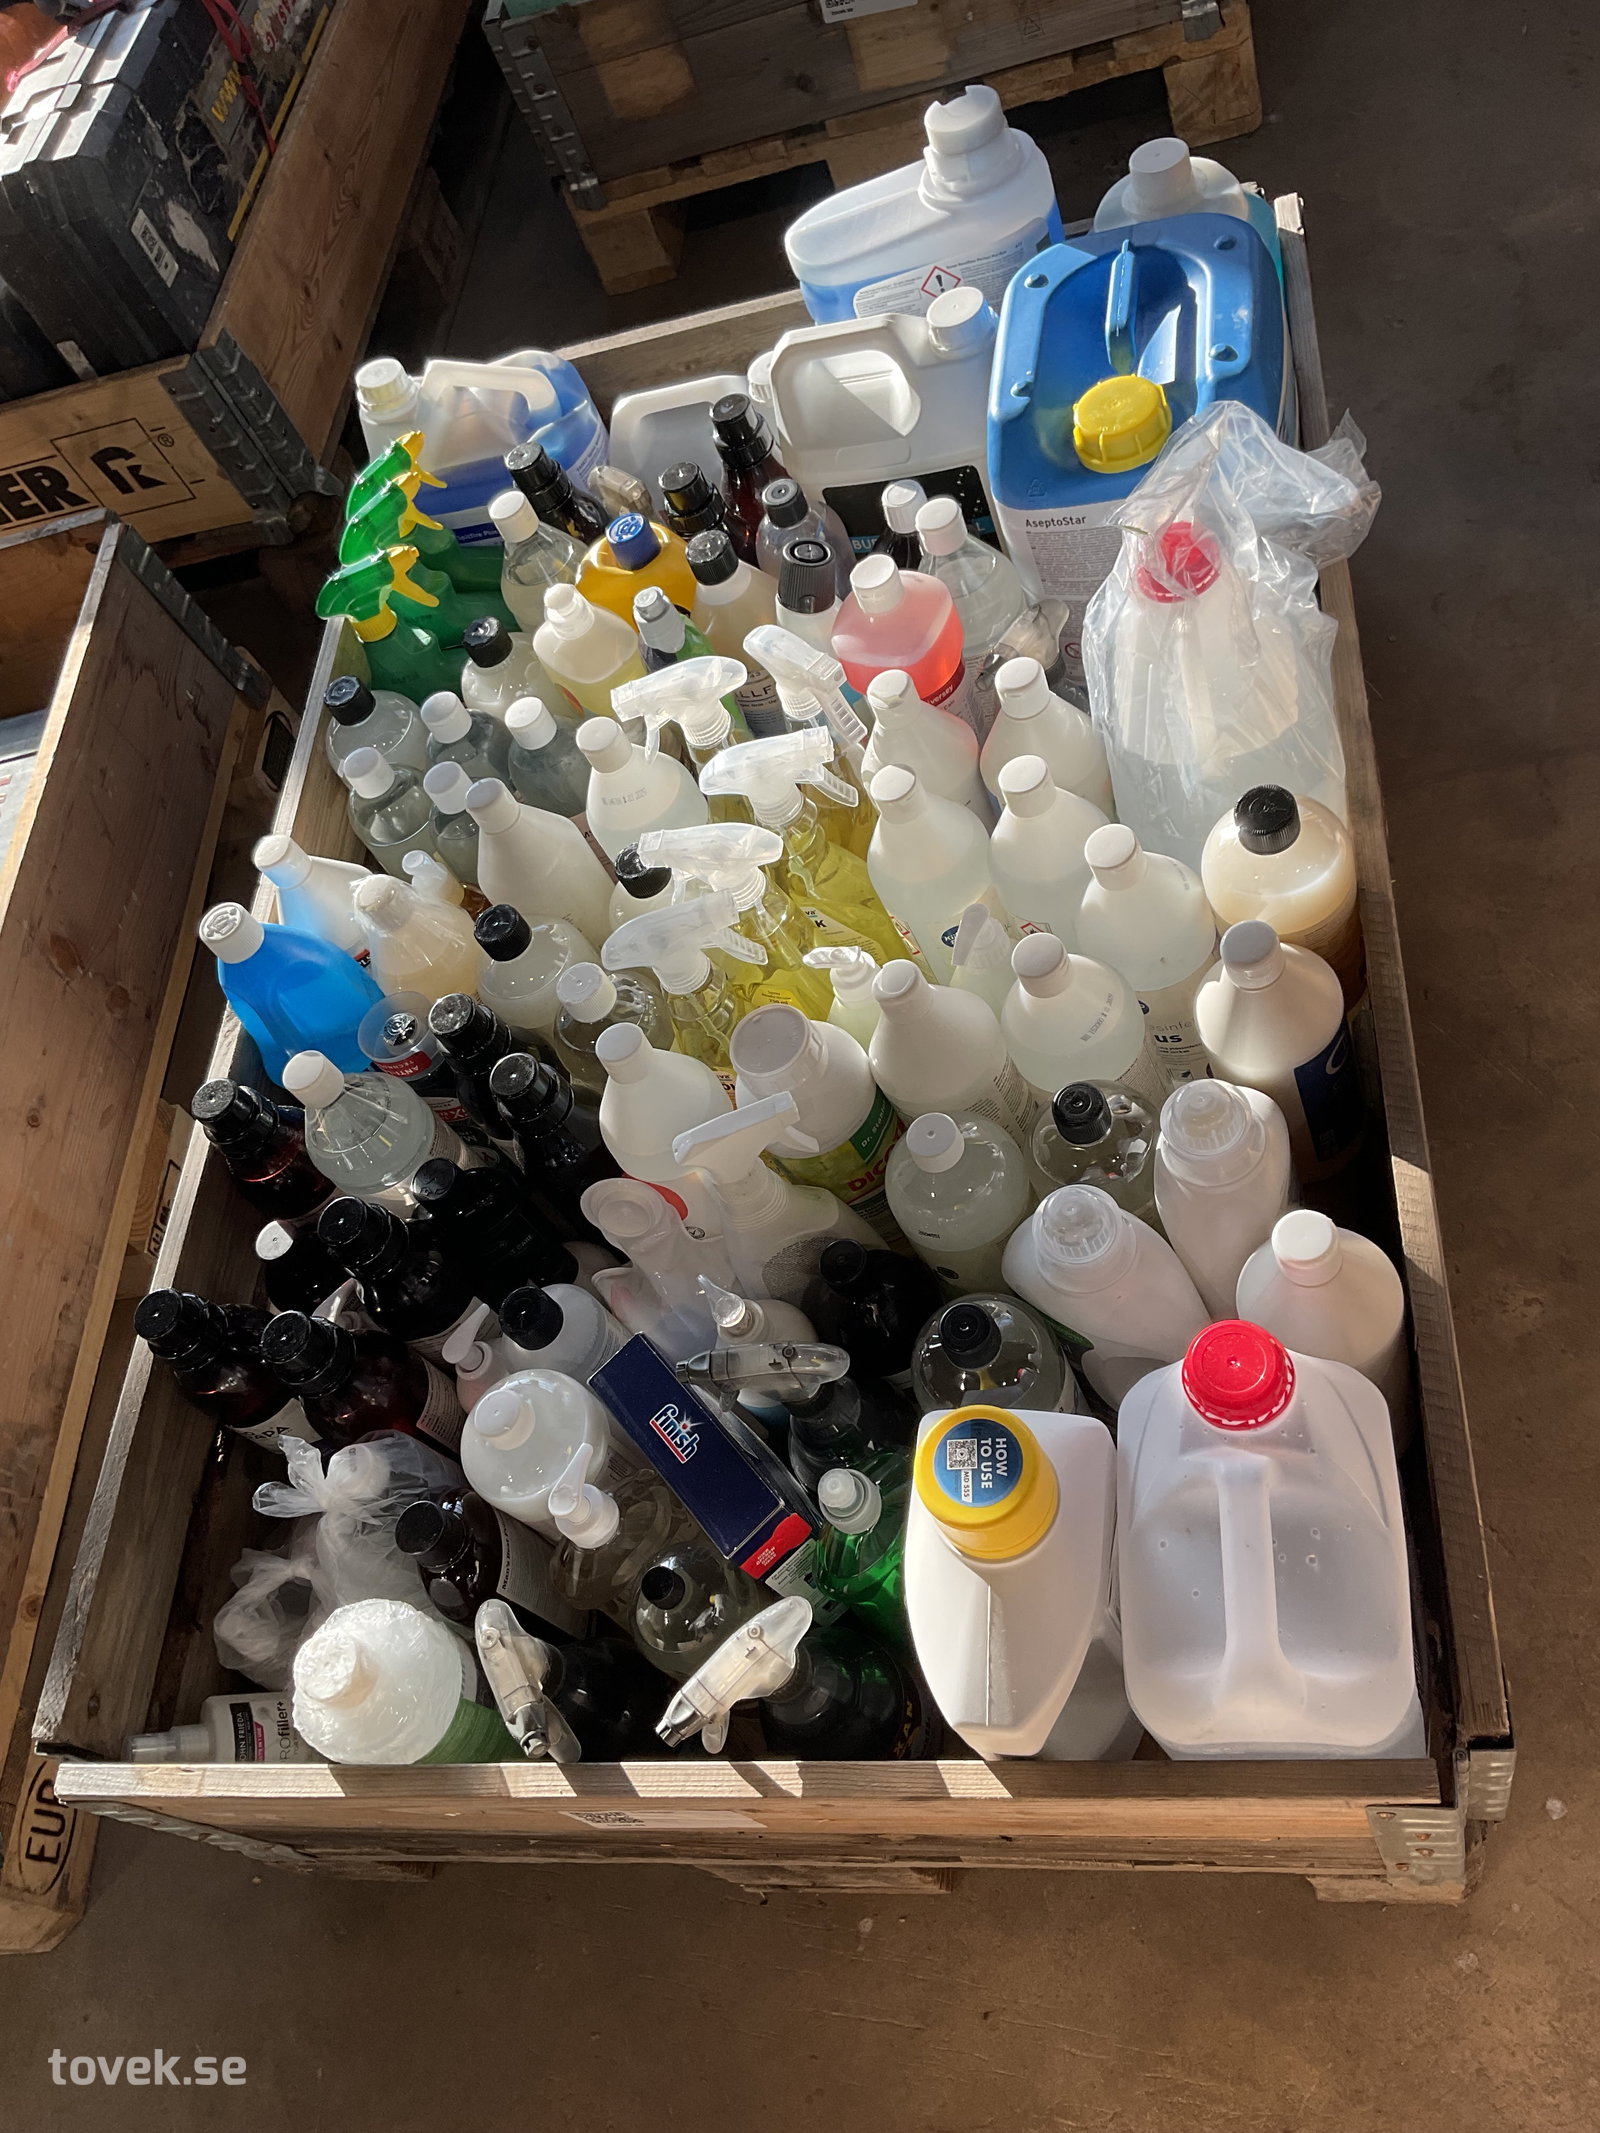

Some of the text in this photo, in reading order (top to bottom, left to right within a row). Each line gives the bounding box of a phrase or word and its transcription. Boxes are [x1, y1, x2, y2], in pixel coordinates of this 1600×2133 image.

[0, 465, 91, 525] ER
[1025, 515, 1087, 529] AseptoStar
[861, 1135, 873, 1148] Dr.
[649, 1404, 700, 1462] finish
[995, 1437, 1008, 1477] HOW
[963, 1471, 970, 1483] MD
[980, 1437, 993, 1489] TO USE
[236, 1712, 248, 1762] OHN FRIEDA
[276, 1701, 291, 1761] ROfiller+
